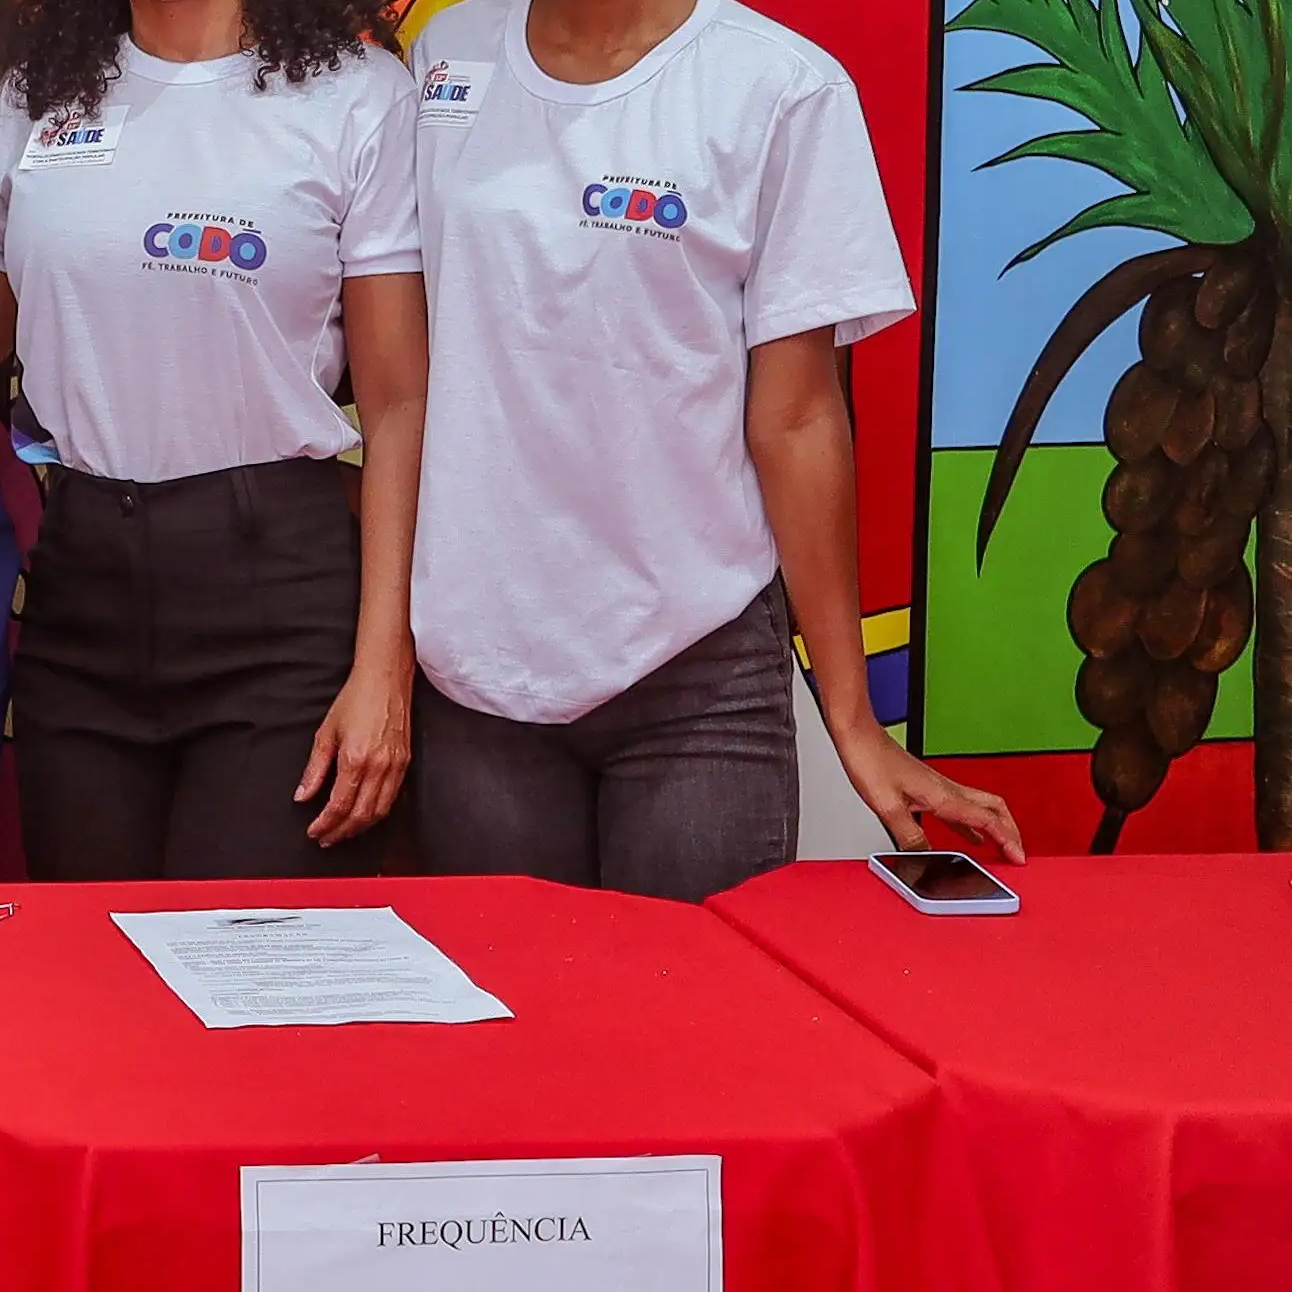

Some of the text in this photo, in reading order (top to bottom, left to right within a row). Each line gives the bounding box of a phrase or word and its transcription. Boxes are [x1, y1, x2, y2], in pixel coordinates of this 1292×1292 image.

[602, 175, 678, 190] PREFEITURA DE
[166, 211, 255, 228] PREFEITURA DE
[591, 220, 633, 233] TRABALHO
[635, 226, 642, 235] E
[158, 262, 208, 275] TRABALHO
[211, 267, 218, 277] E
[219, 270, 260, 286] FUTURO
[377, 1211, 593, 1251] FREQUÊNCIA
